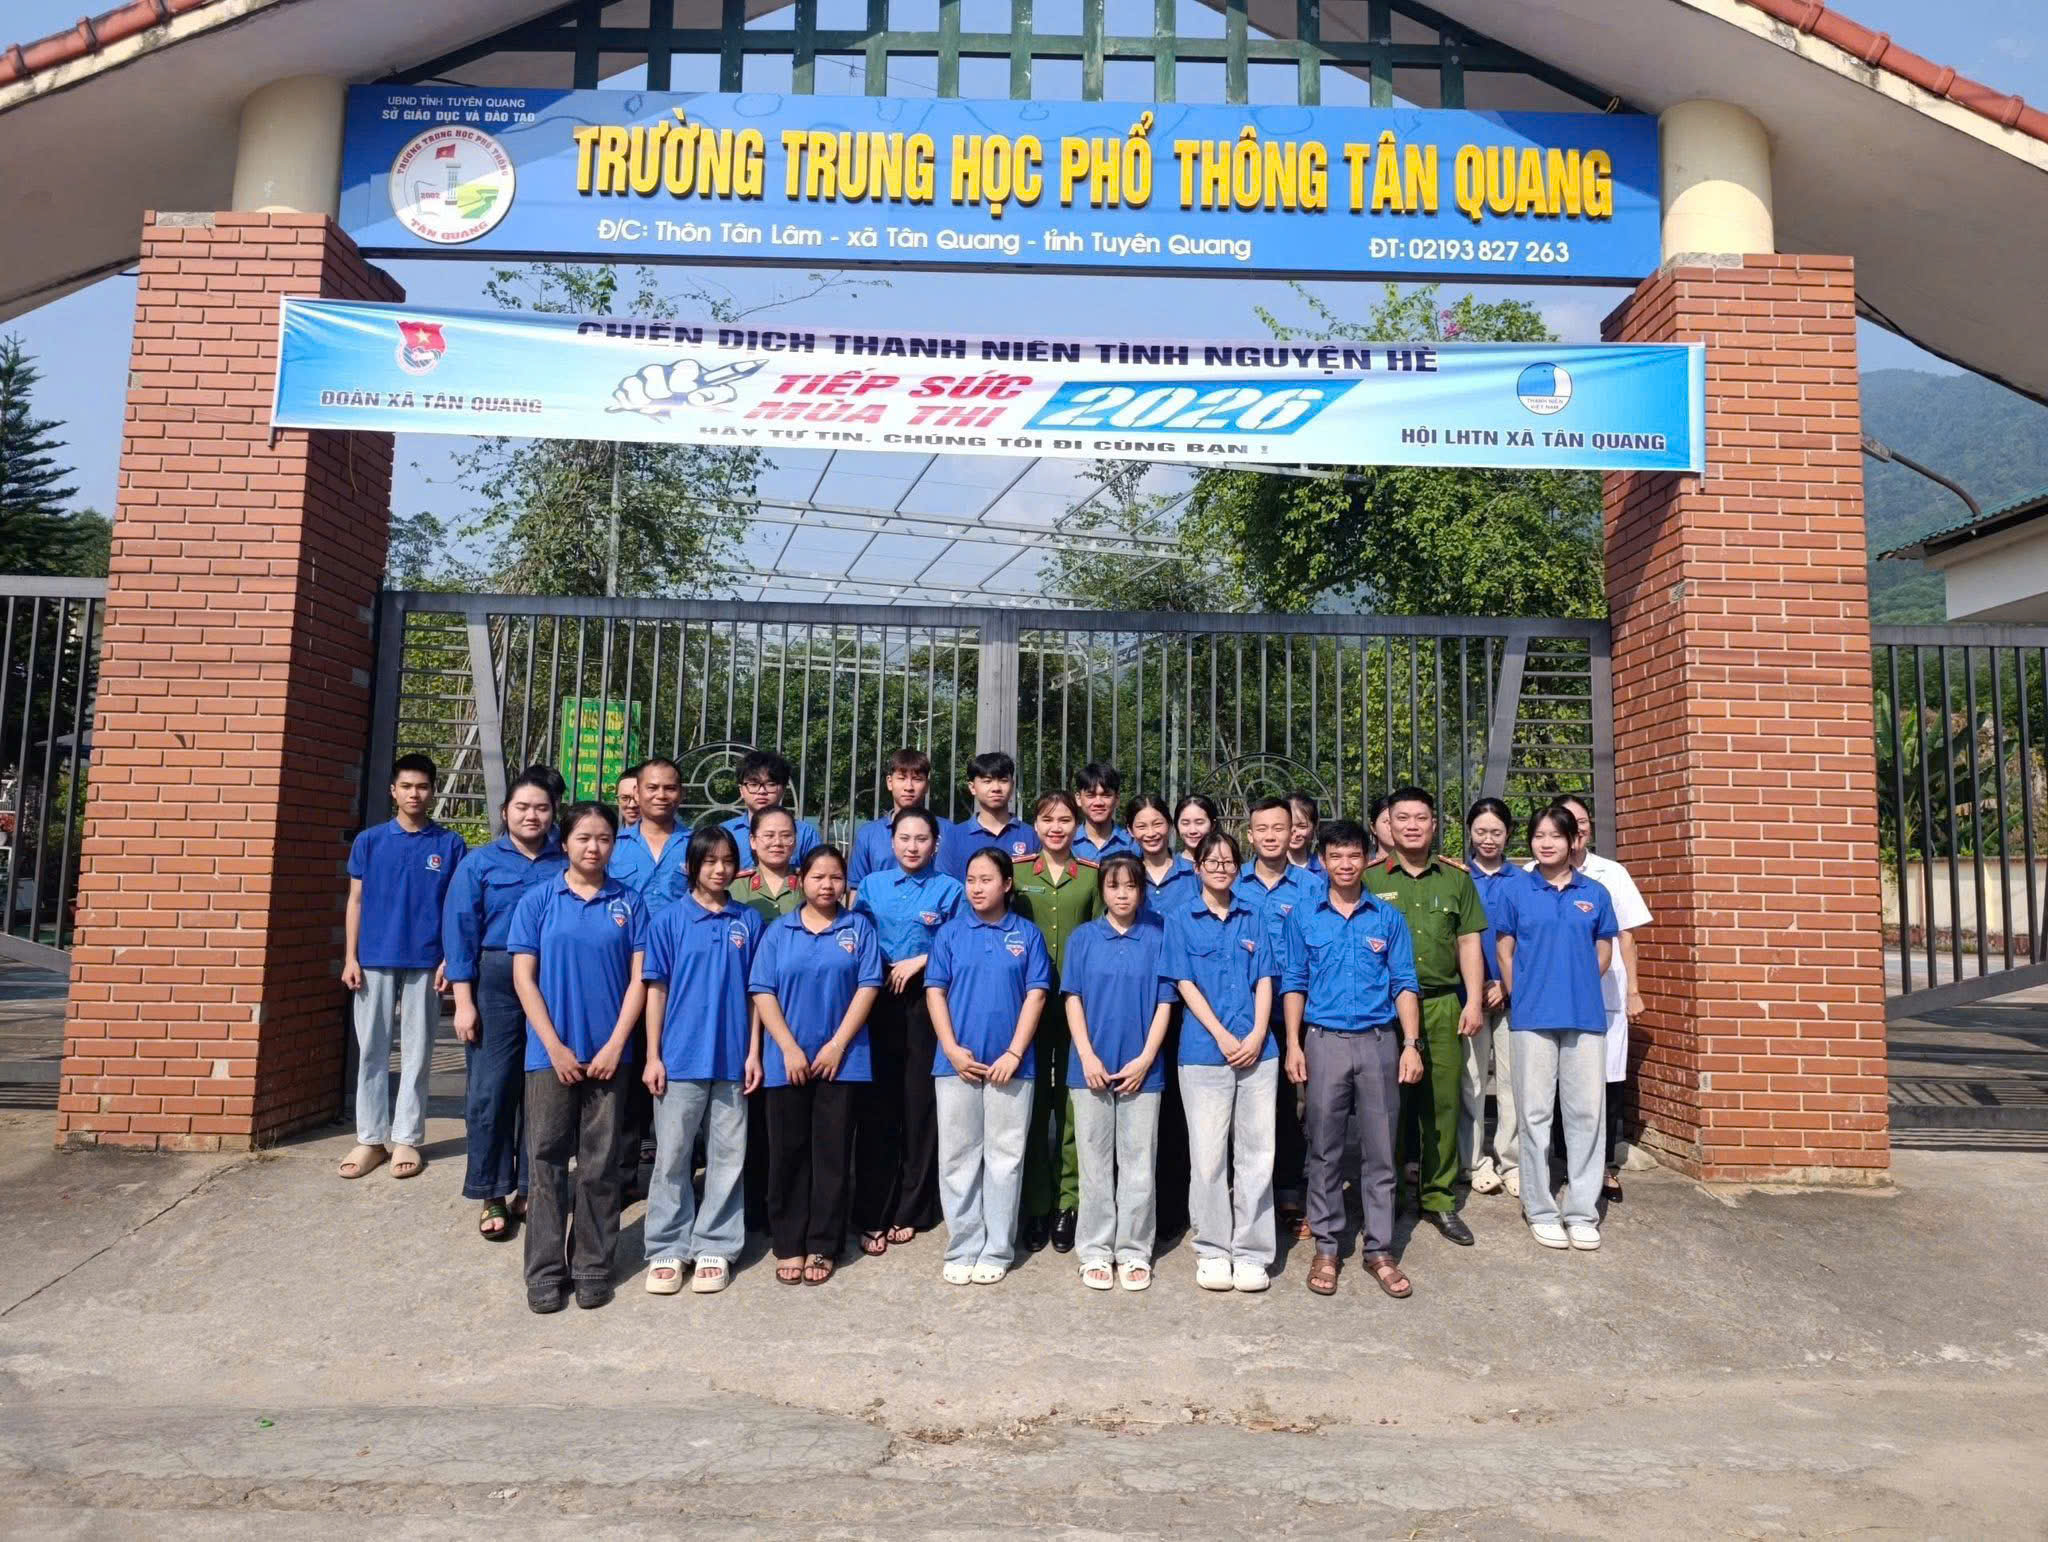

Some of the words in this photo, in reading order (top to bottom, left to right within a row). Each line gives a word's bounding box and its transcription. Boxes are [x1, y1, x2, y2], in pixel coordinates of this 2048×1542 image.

[388, 96, 417, 105] UBND
[448, 96, 483, 107] TUYÊN
[486, 98, 526, 108] QUANG
[403, 108, 431, 121] GIÁO
[436, 111, 460, 124] DỤC
[465, 109, 480, 121] VÀ
[485, 110, 508, 122] ĐÀO
[513, 112, 536, 125] TẠO
[573, 107, 766, 198] TRƯỜNG
[781, 130, 935, 202] TRUNG
[951, 134, 1043, 218] HỌC
[1060, 111, 1154, 208] PHỔ
[1174, 125, 1328, 212] THÔNG
[1344, 130, 1439, 214] TÂN
[1455, 144, 1614, 222] QUANG
[441, 220, 489, 240] QUANG
[597, 218, 648, 241] Đ/C:
[655, 220, 712, 243] Thôn
[720, 223, 762, 244] Tân
[771, 224, 822, 247] Lâm
[847, 227, 878, 247] xã
[887, 226, 928, 249] Tân
[936, 229, 1020, 256] Quang
[1043, 228, 1084, 253] tỉnh
[1091, 231, 1161, 257] Tuyên
[1168, 234, 1251, 261] Quang
[1369, 237, 1406, 260] ĐT:
[1409, 238, 1475, 261] 02193
[1478, 239, 1520, 262] 827
[1525, 241, 1570, 263] 263
[829, 334, 967, 359] THANH
[981, 340, 1081, 363] NIÊN
[1095, 341, 1189, 366] TÌNH
[1204, 345, 1372, 375] NGUYỆN
[1387, 346, 1438, 372] HÈ
[773, 367, 901, 397] TIẾP
[908, 369, 1034, 400] SỨC
[321, 388, 380, 406] ĐOÀN
[387, 391, 415, 408] XÃ
[423, 392, 464, 411] TÂN
[471, 396, 543, 413] QUANG
[743, 399, 889, 424] MÙA
[906, 404, 1009, 428] THI
[1037, 385, 1326, 431] 2026
[883, 433, 987, 447] CHÚNG
[997, 436, 1042, 449] TÔI
[1053, 438, 1082, 450] ĐI
[1093, 439, 1176, 452] CÙNG
[1186, 442, 1249, 455] BẠN
[1401, 425, 1438, 448] HỘI
[1445, 429, 1499, 446] LHTN
[1506, 427, 1535, 447] XÃ
[1542, 428, 1585, 448] TÂN
[1592, 432, 1666, 450] QUANG
